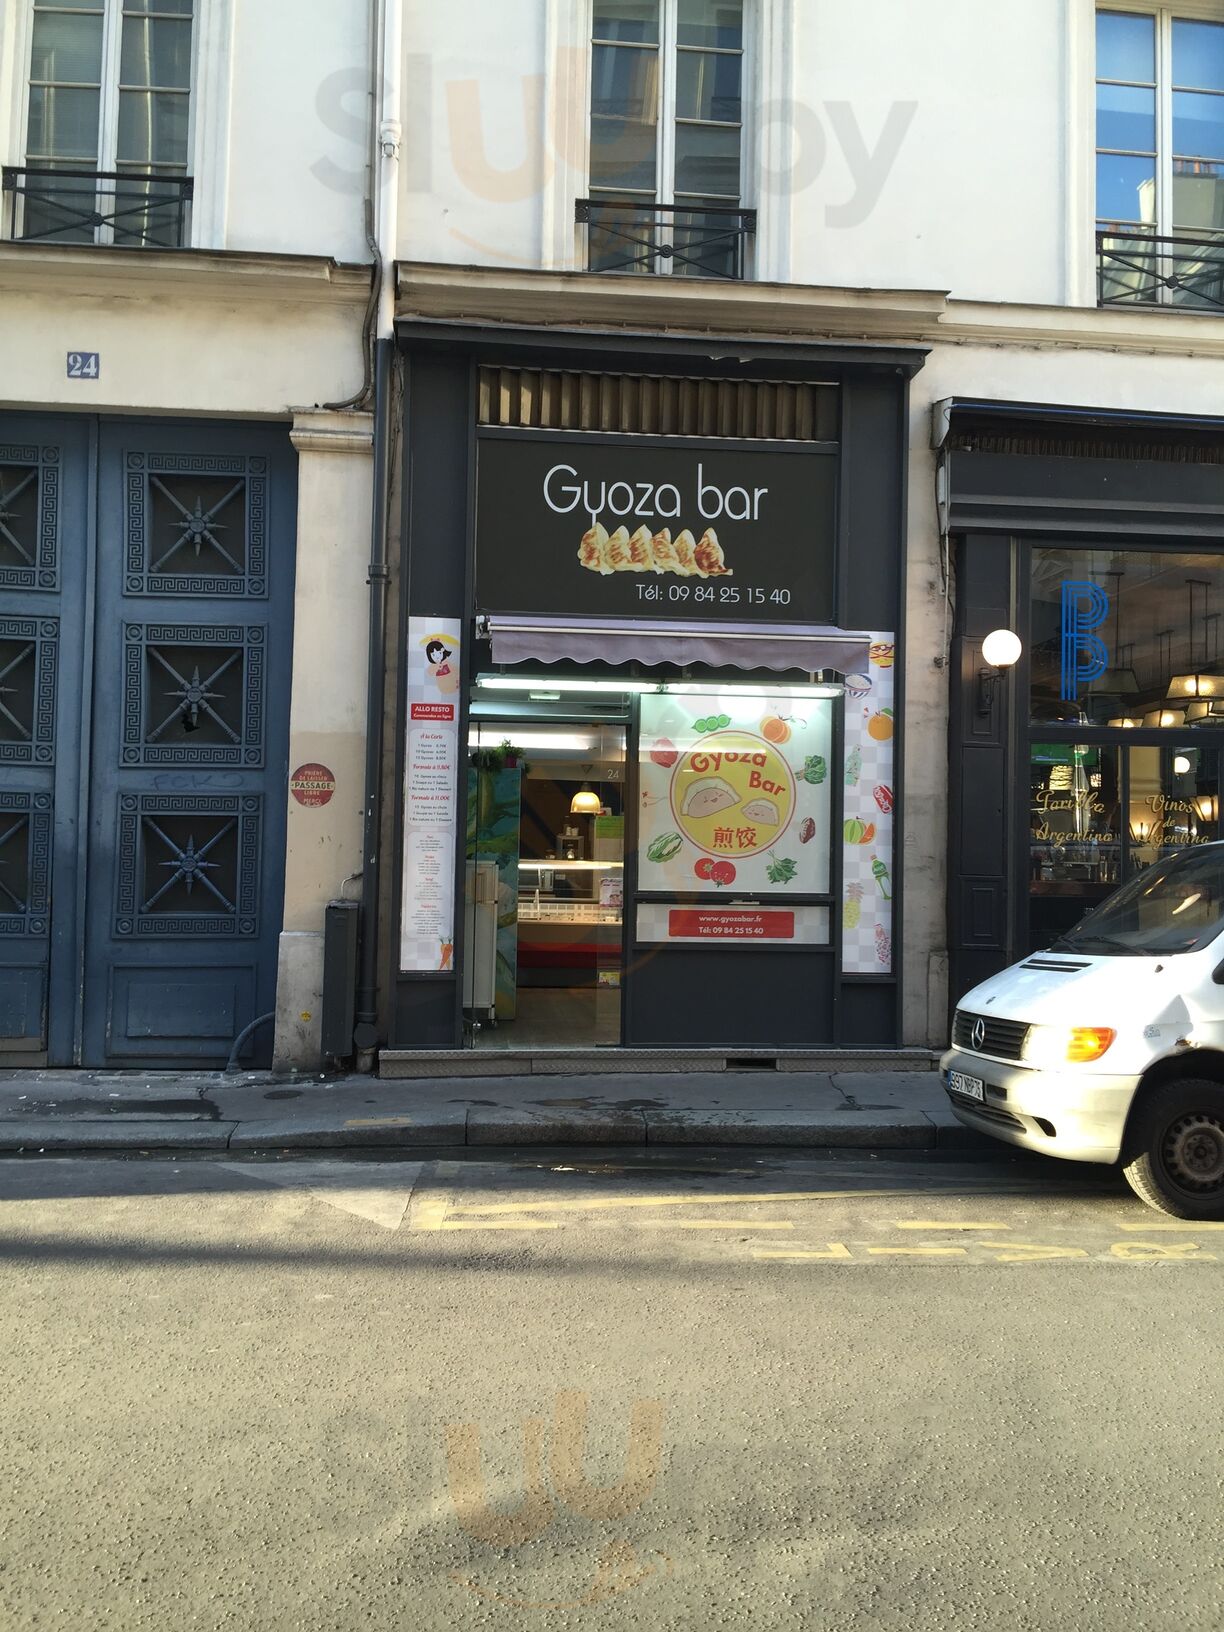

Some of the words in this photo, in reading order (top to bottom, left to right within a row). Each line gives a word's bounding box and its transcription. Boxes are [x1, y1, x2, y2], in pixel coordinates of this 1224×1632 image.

[68, 354, 97, 376] 24
[543, 463, 681, 527] Gyoza
[697, 463, 768, 521] bar
[636, 584, 663, 601] Tél:
[669, 585, 690, 601] 09
[694, 586, 715, 602] 84
[719, 586, 740, 603] 25
[747, 587, 765, 604] 15
[769, 588, 791, 605] 40
[690, 749, 768, 773] Gyoza
[607, 769, 619, 779] 24
[748, 770, 786, 797] Bar
[294, 782, 331, 790] PASSAGE
[1145, 794, 1194, 814] Vinos
[1162, 816, 1176, 828] de
[713, 826, 757, 849] 煎饺
[1138, 826, 1209, 850] rgentina
[698, 915, 763, 924] www.gyozabar.fr
[712, 926, 723, 934] 09
[734, 927, 745, 935] 25
[745, 927, 753, 935] 15
[753, 927, 764, 935] 40
